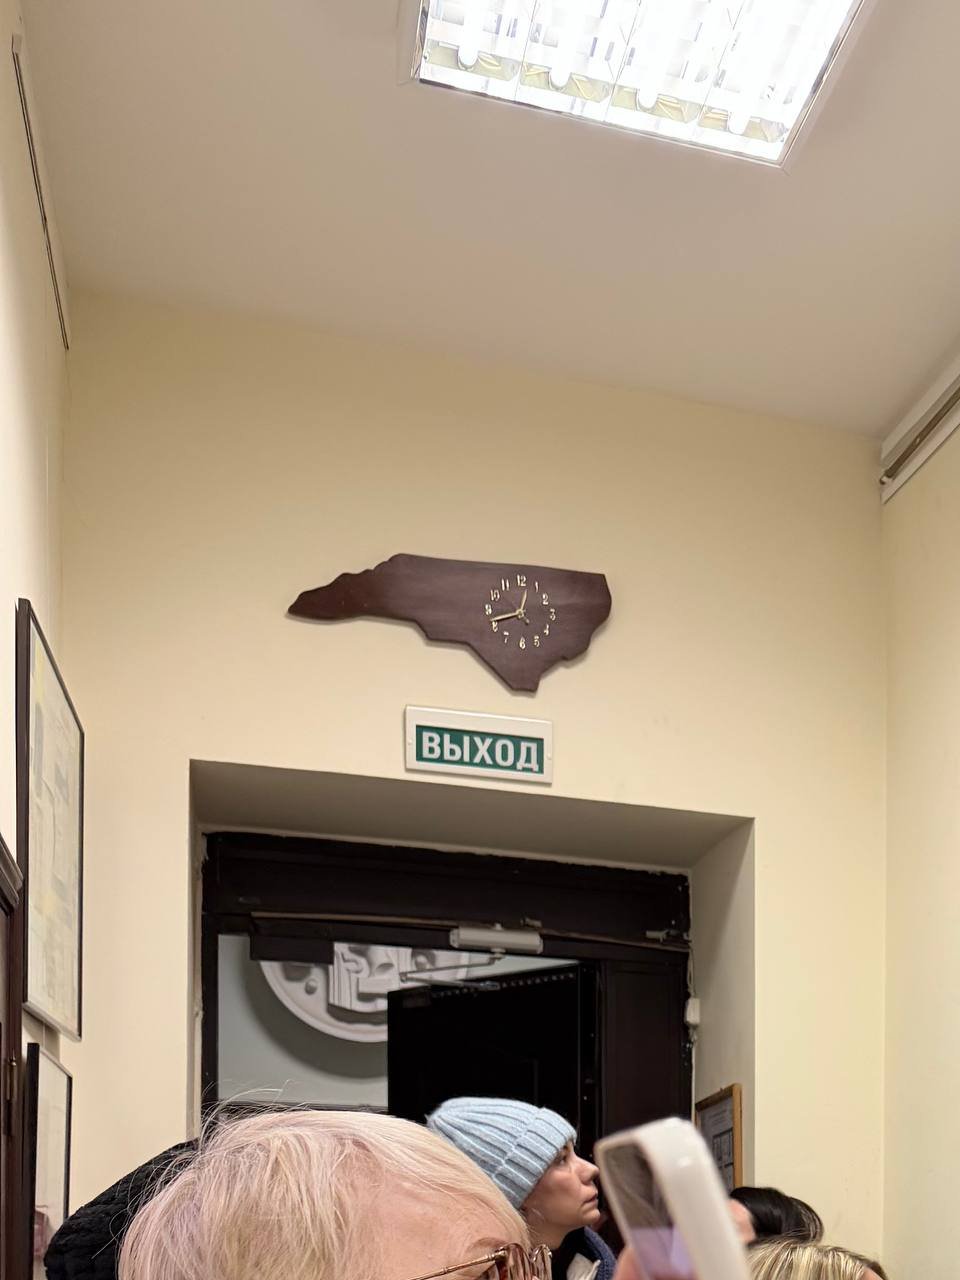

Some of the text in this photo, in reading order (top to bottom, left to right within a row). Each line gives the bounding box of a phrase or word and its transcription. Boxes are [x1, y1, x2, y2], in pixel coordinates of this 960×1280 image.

[501, 578, 509, 591] 11
[517, 574, 527, 587] 12
[535, 581, 539, 593] 1
[490, 589, 500, 601] 10
[542, 592, 549, 605] 2
[485, 604, 492, 615] 9
[550, 608, 556, 621] 3
[492, 620, 498, 632] 8
[543, 624, 549, 636] 4
[503, 631, 509, 644] 7
[519, 637, 526, 649] 6
[534, 635, 540, 647] 5
[422, 731, 539, 771] ВЫХОД
